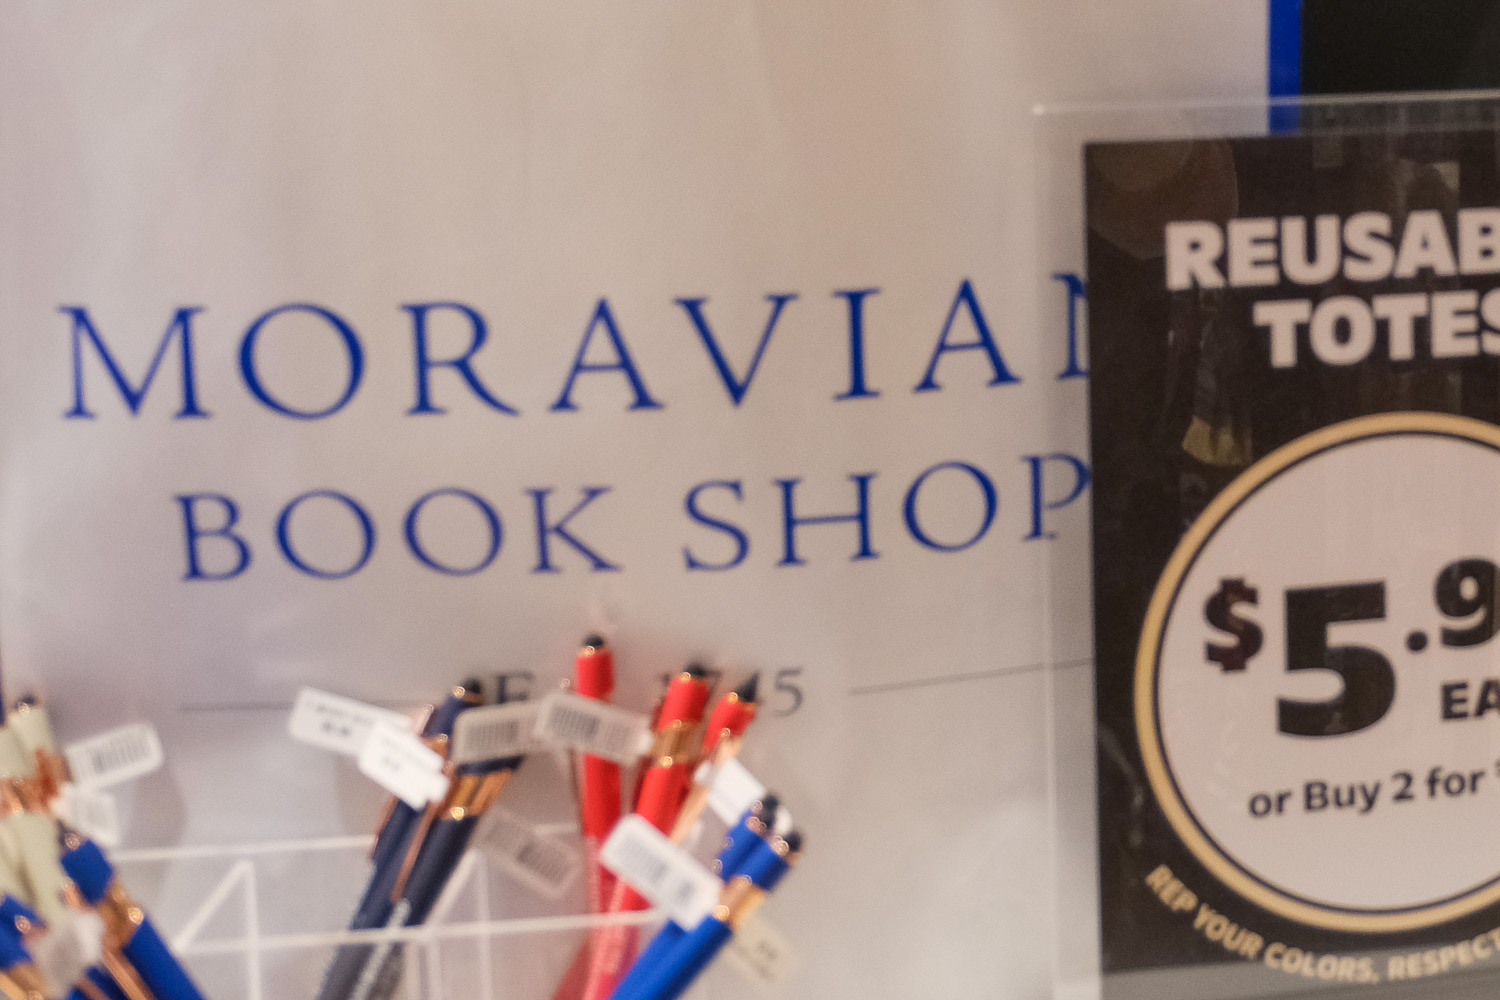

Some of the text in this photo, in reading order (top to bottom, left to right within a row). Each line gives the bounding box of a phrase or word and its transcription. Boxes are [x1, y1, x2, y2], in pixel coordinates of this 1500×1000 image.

[172, 450, 1091, 582] BOOK SHOP
[1248, 789, 1292, 819] or
[1303, 780, 1382, 816] Buy
[1391, 771, 1415, 802] 2
[1426, 763, 1487, 799] for
[1145, 864, 1199, 913] REP
[1192, 902, 1265, 960] YOUR
